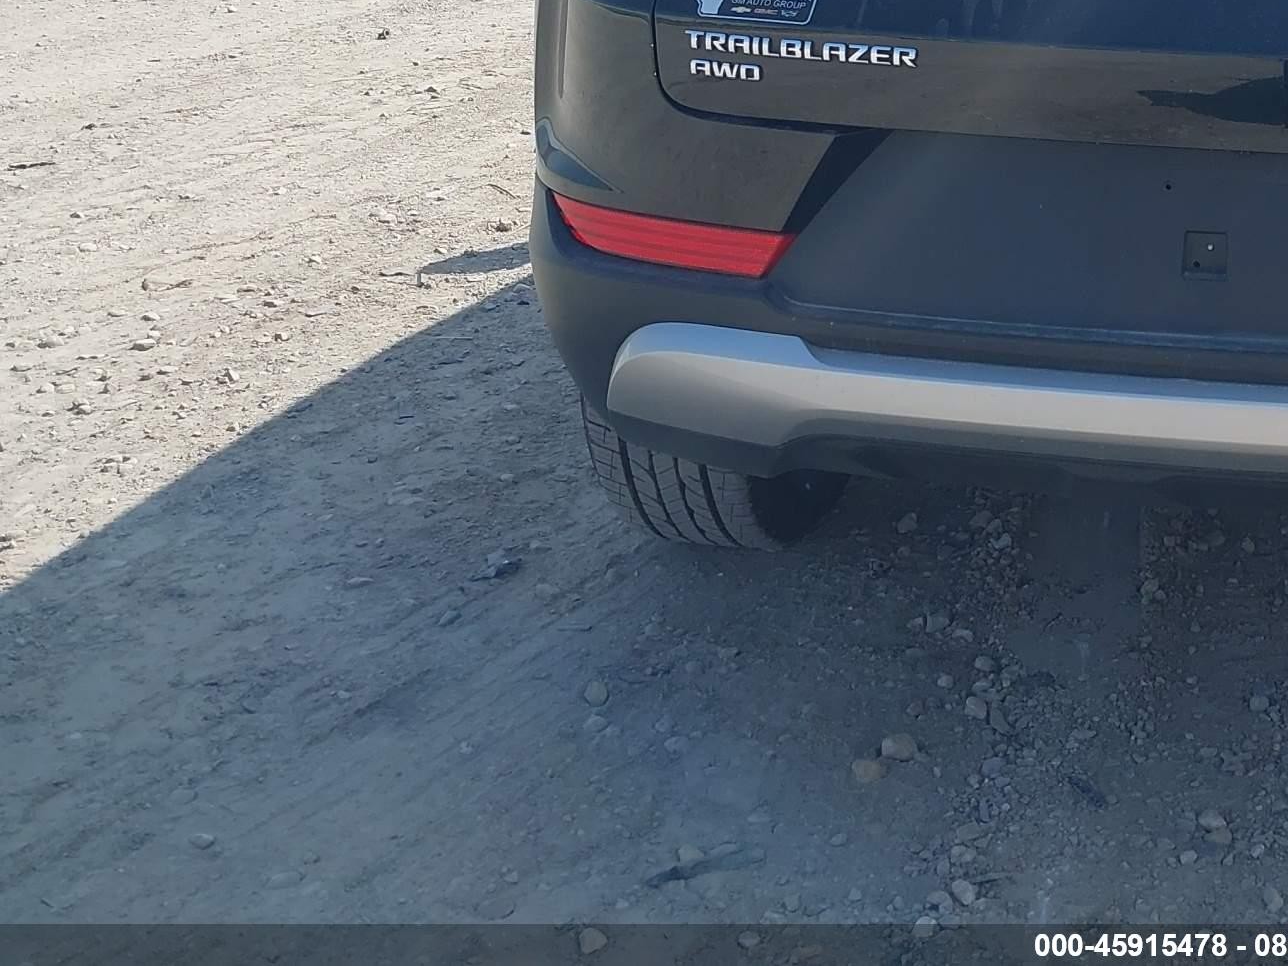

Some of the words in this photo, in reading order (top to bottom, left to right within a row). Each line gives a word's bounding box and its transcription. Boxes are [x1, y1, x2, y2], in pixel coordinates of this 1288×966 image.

[773, 0, 807, 9] GROUP
[685, 29, 918, 68] TRAILBLAZER
[690, 59, 760, 81] AWD
